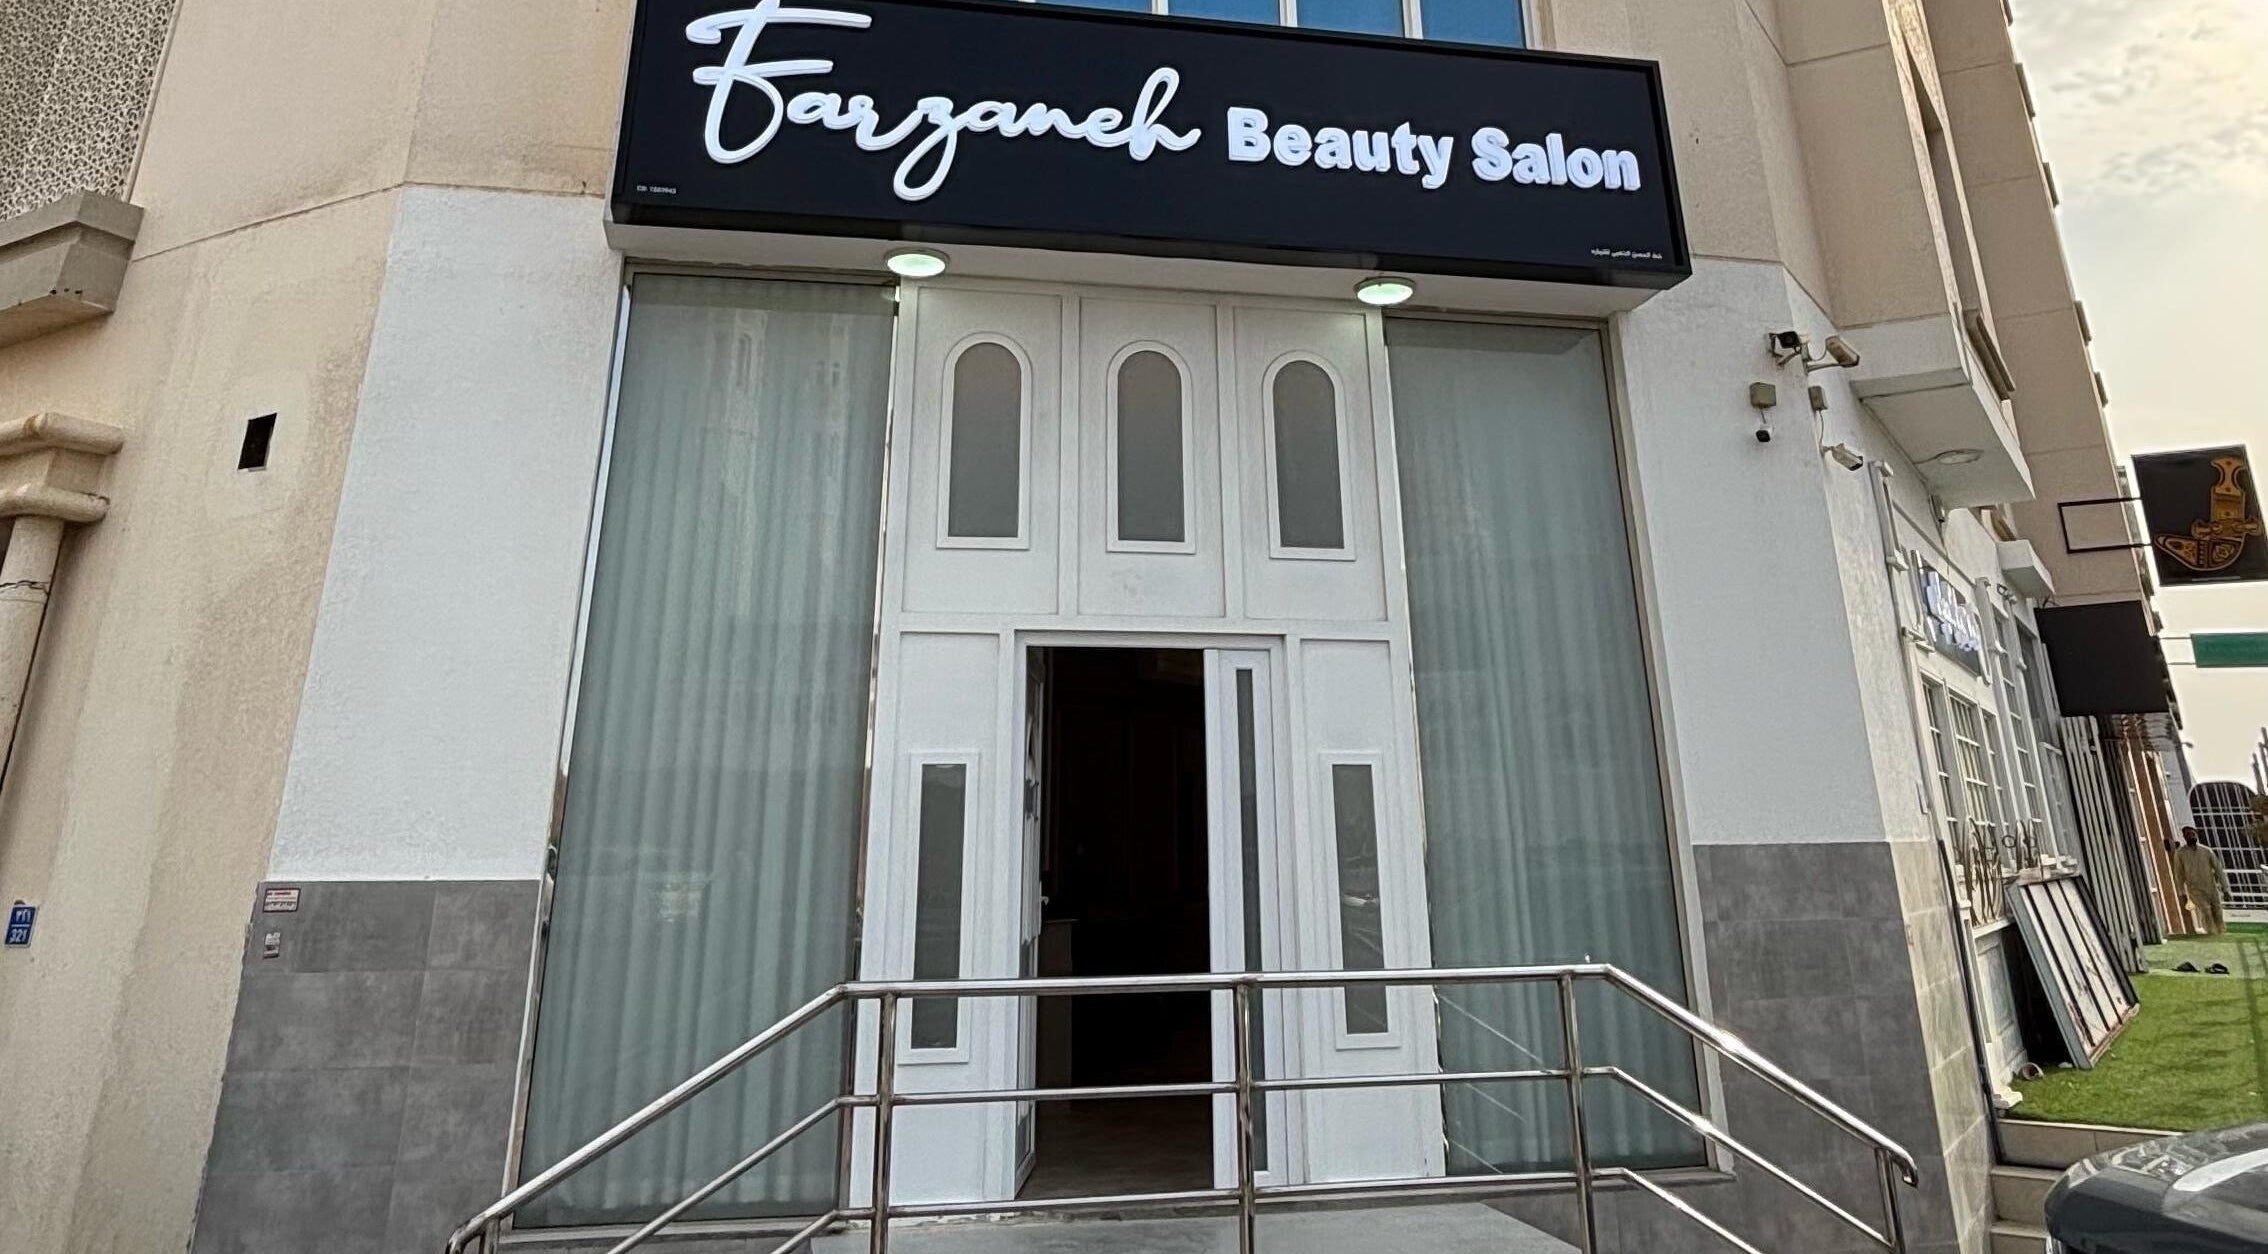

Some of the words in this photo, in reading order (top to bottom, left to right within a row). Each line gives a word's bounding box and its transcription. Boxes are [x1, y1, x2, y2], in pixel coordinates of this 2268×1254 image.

[685, 0, 1201, 201] Farzaneh
[1226, 106, 1454, 190] Beauty
[1471, 126, 1641, 192] Salon
[9, 928, 27, 943] 321
